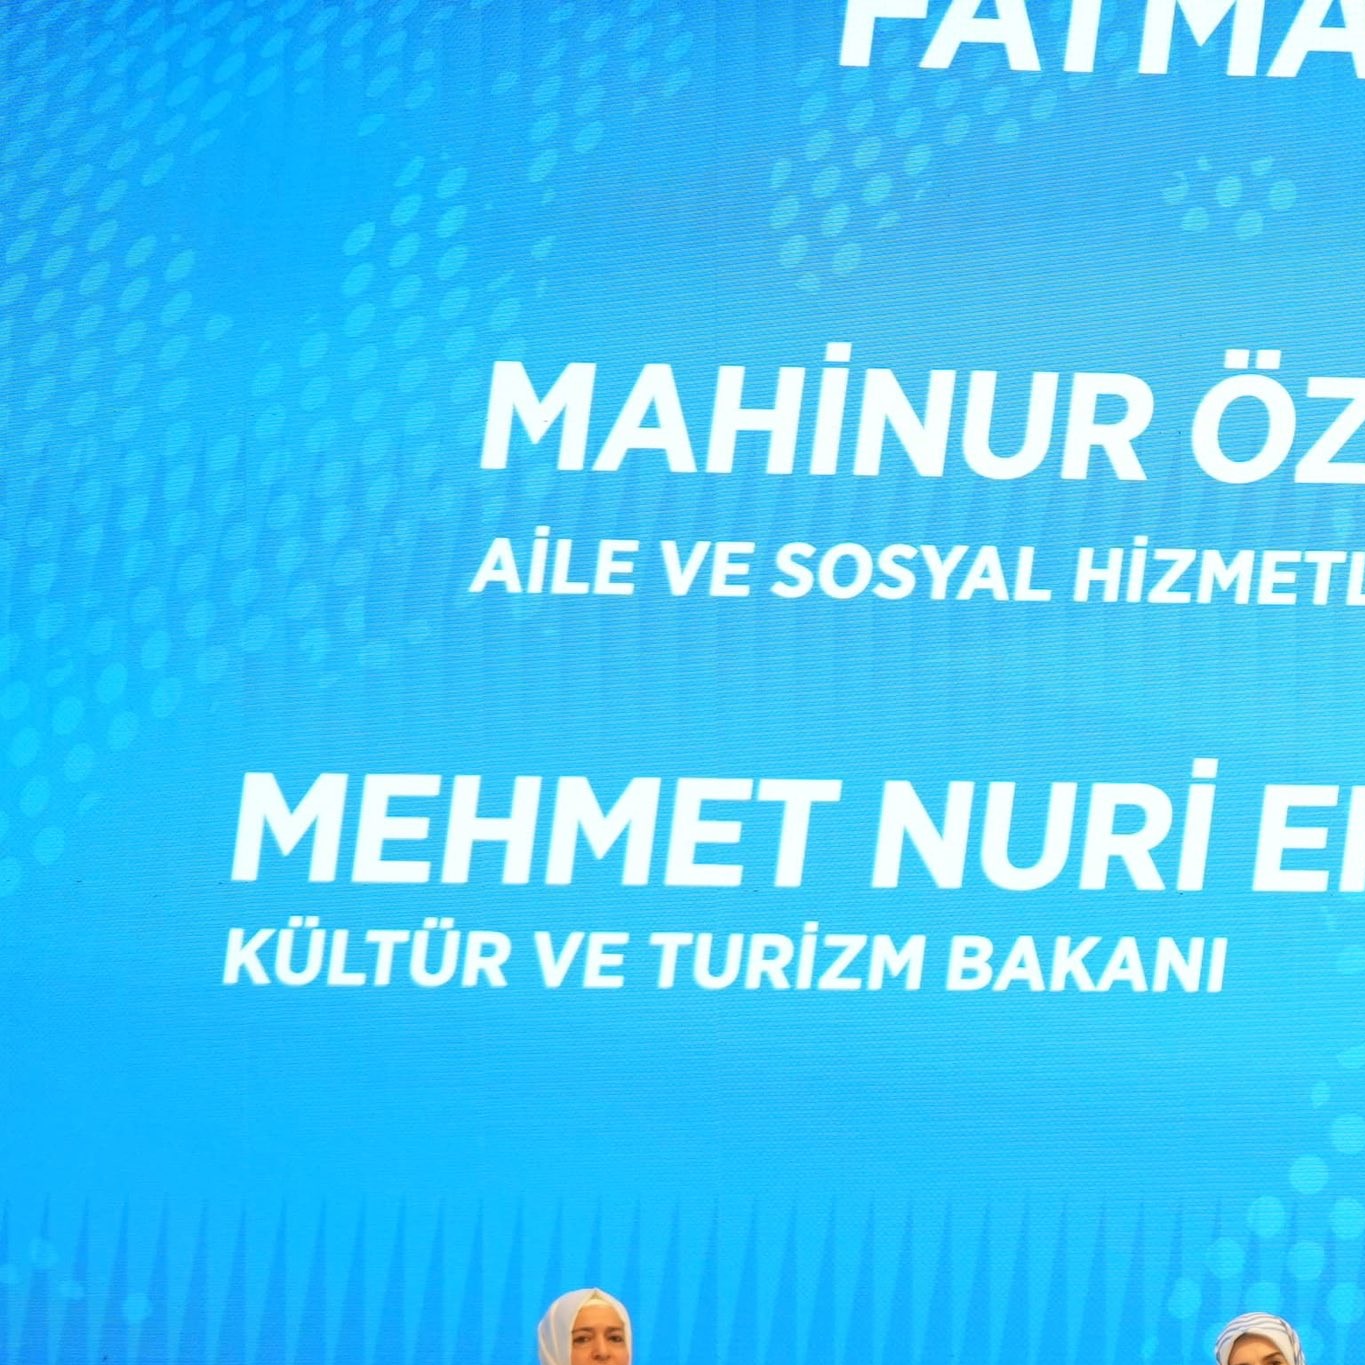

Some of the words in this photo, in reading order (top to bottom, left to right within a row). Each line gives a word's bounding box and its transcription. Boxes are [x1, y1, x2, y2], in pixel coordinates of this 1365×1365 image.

[481, 342, 1154, 481] MAHİNUR
[469, 525, 640, 595] AİLE
[660, 540, 756, 597] VE
[771, 542, 1052, 601] SOSYAL
[232, 772, 842, 888] MEHMET
[872, 758, 1218, 892] NURİ
[224, 916, 511, 987] KÜLTÜR
[535, 931, 630, 988] VE
[650, 921, 926, 990] TURİZM
[947, 935, 1228, 993] BAKANI
